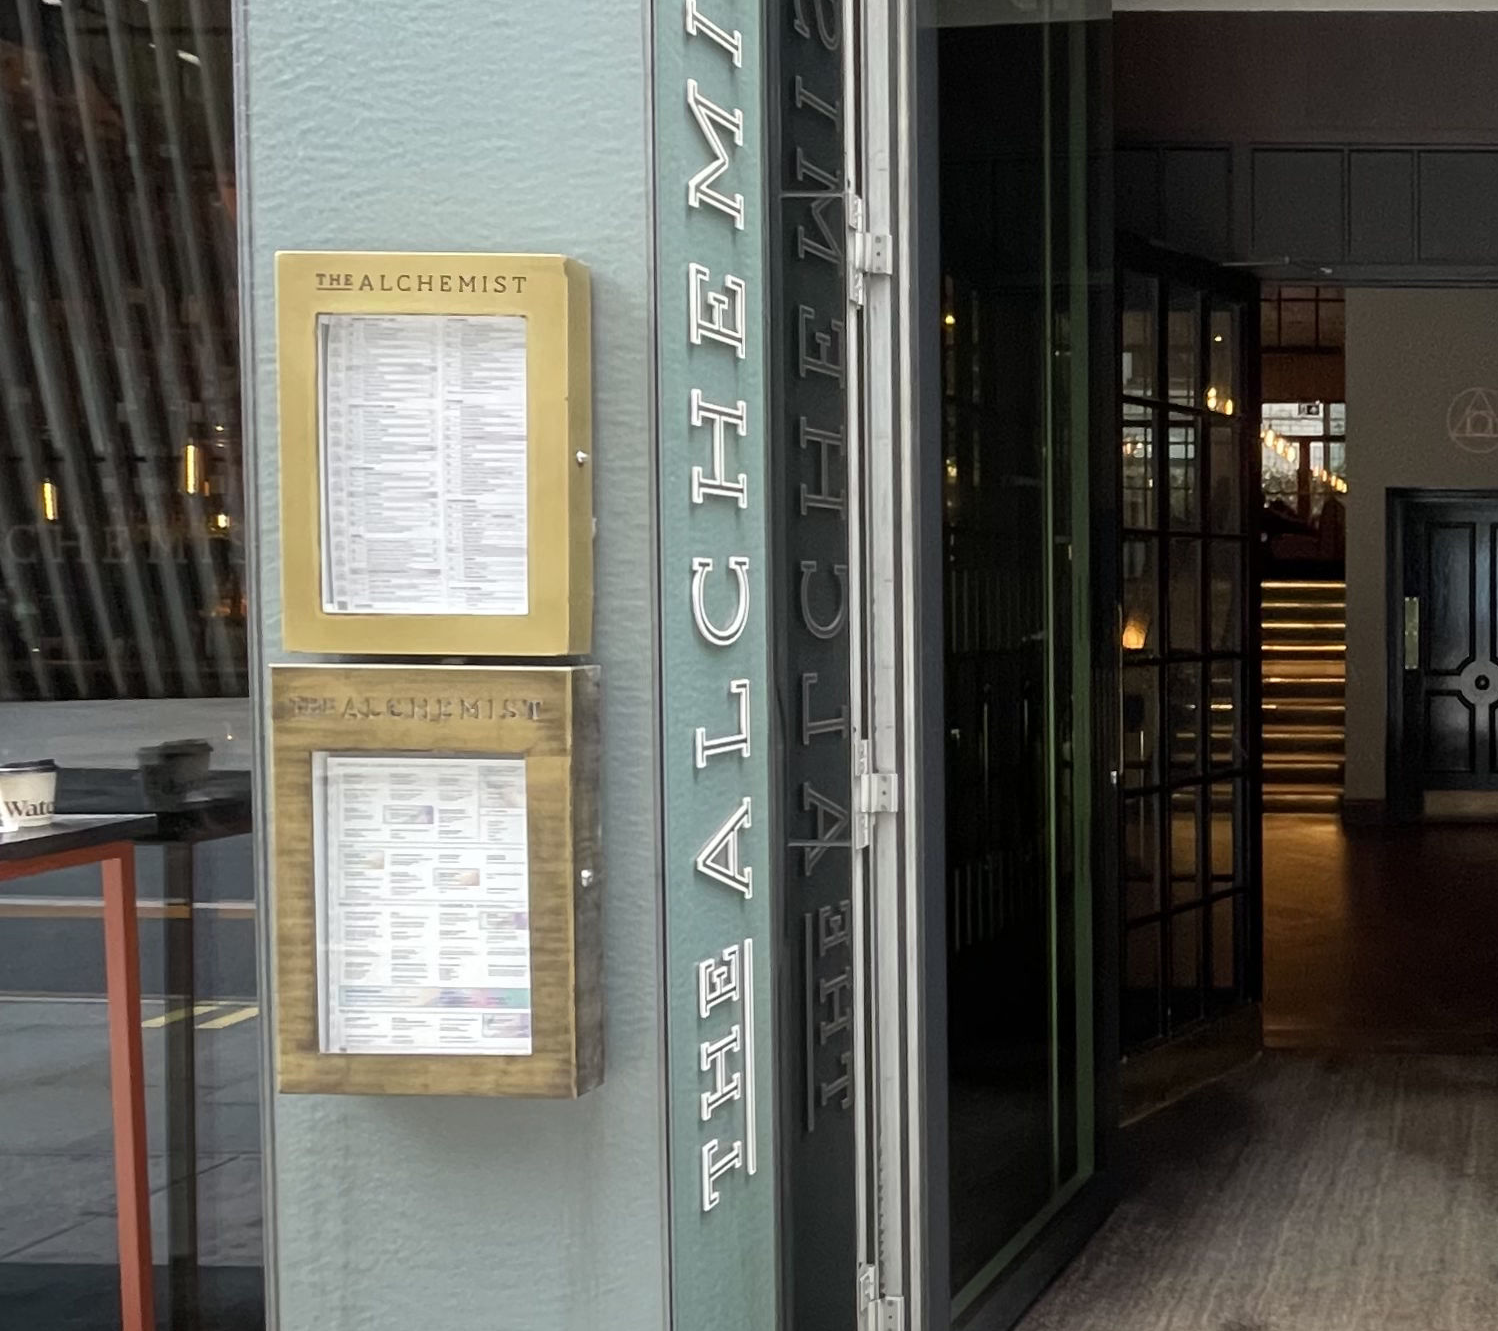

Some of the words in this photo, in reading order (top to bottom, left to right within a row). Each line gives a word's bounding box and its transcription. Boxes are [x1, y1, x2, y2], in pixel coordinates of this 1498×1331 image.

[315, 273, 353, 287] THE
[358, 274, 527, 293] ALCHEMIST
[342, 696, 543, 720] ALCHEMIST
[699, 944, 743, 1212] THE
